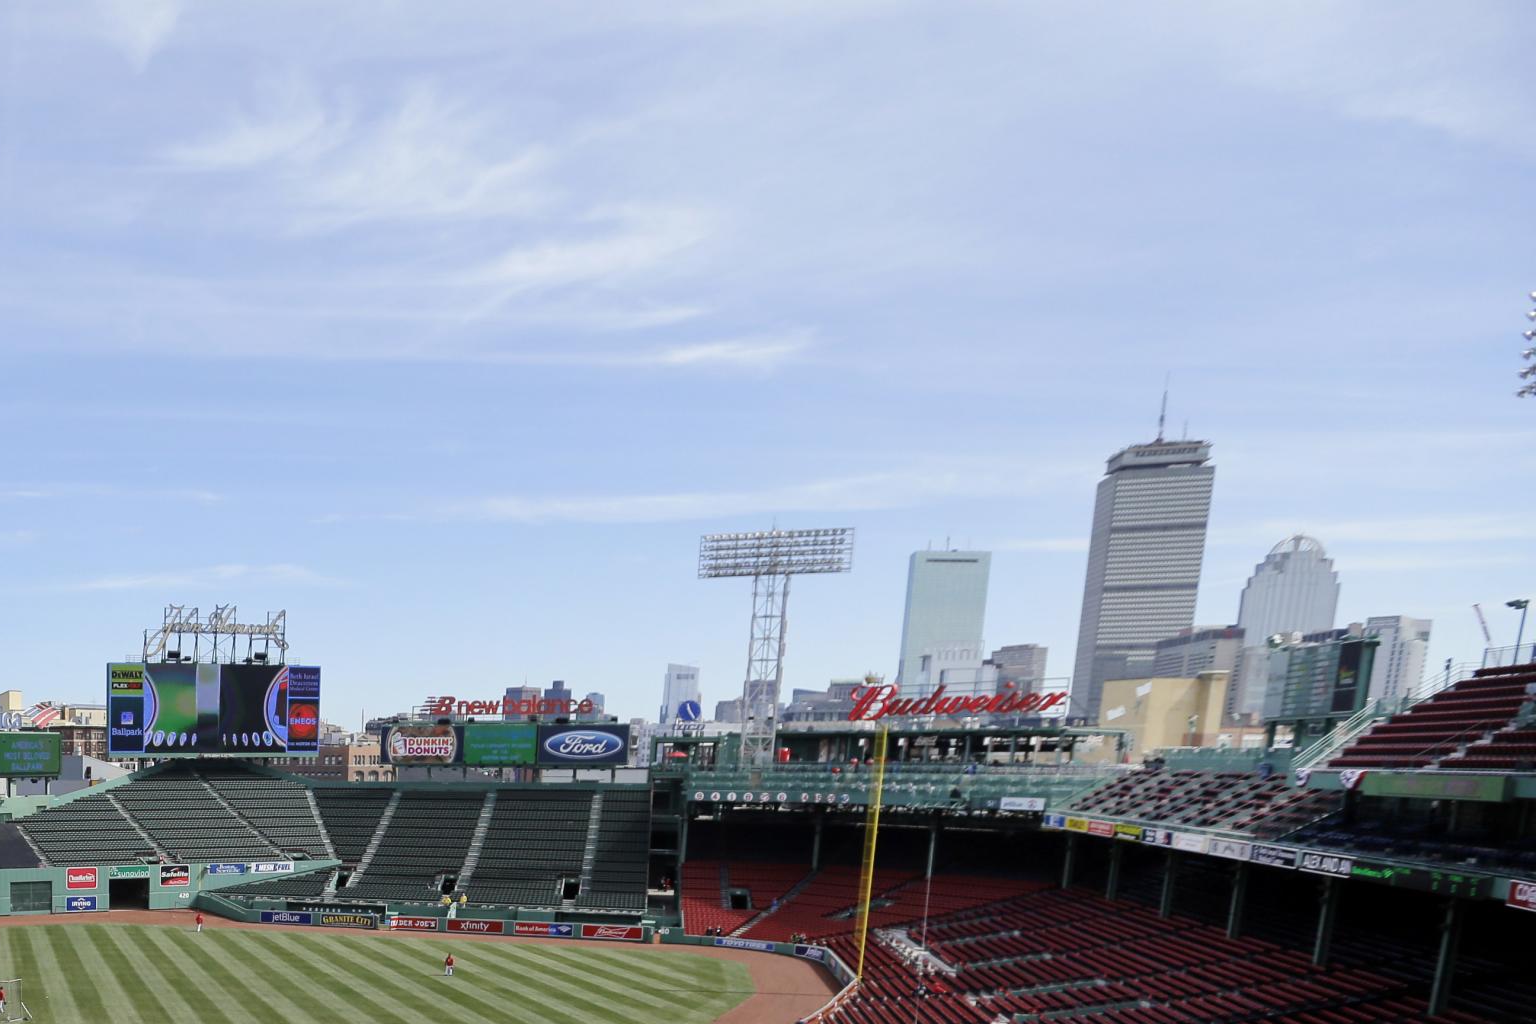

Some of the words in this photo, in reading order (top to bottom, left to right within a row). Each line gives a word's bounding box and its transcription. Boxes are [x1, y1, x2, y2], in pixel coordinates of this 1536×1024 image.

[145, 604, 203, 657] John
[208, 604, 290, 650] Hancock
[457, 700, 499, 715] new
[503, 696, 594, 715] balance
[848, 681, 1069, 721] Budweiser
[112, 728, 143, 736] Ballpark
[408, 738, 452, 747] DUNKIN'
[560, 735, 606, 754] Ford
[408, 747, 450, 755] DONUTS
[272, 912, 300, 922] jetBlue
[323, 915, 354, 924] GRANITE
[355, 916, 373, 926] CITY
[415, 920, 436, 928] JOE'S
[460, 921, 489, 932] xfinity
